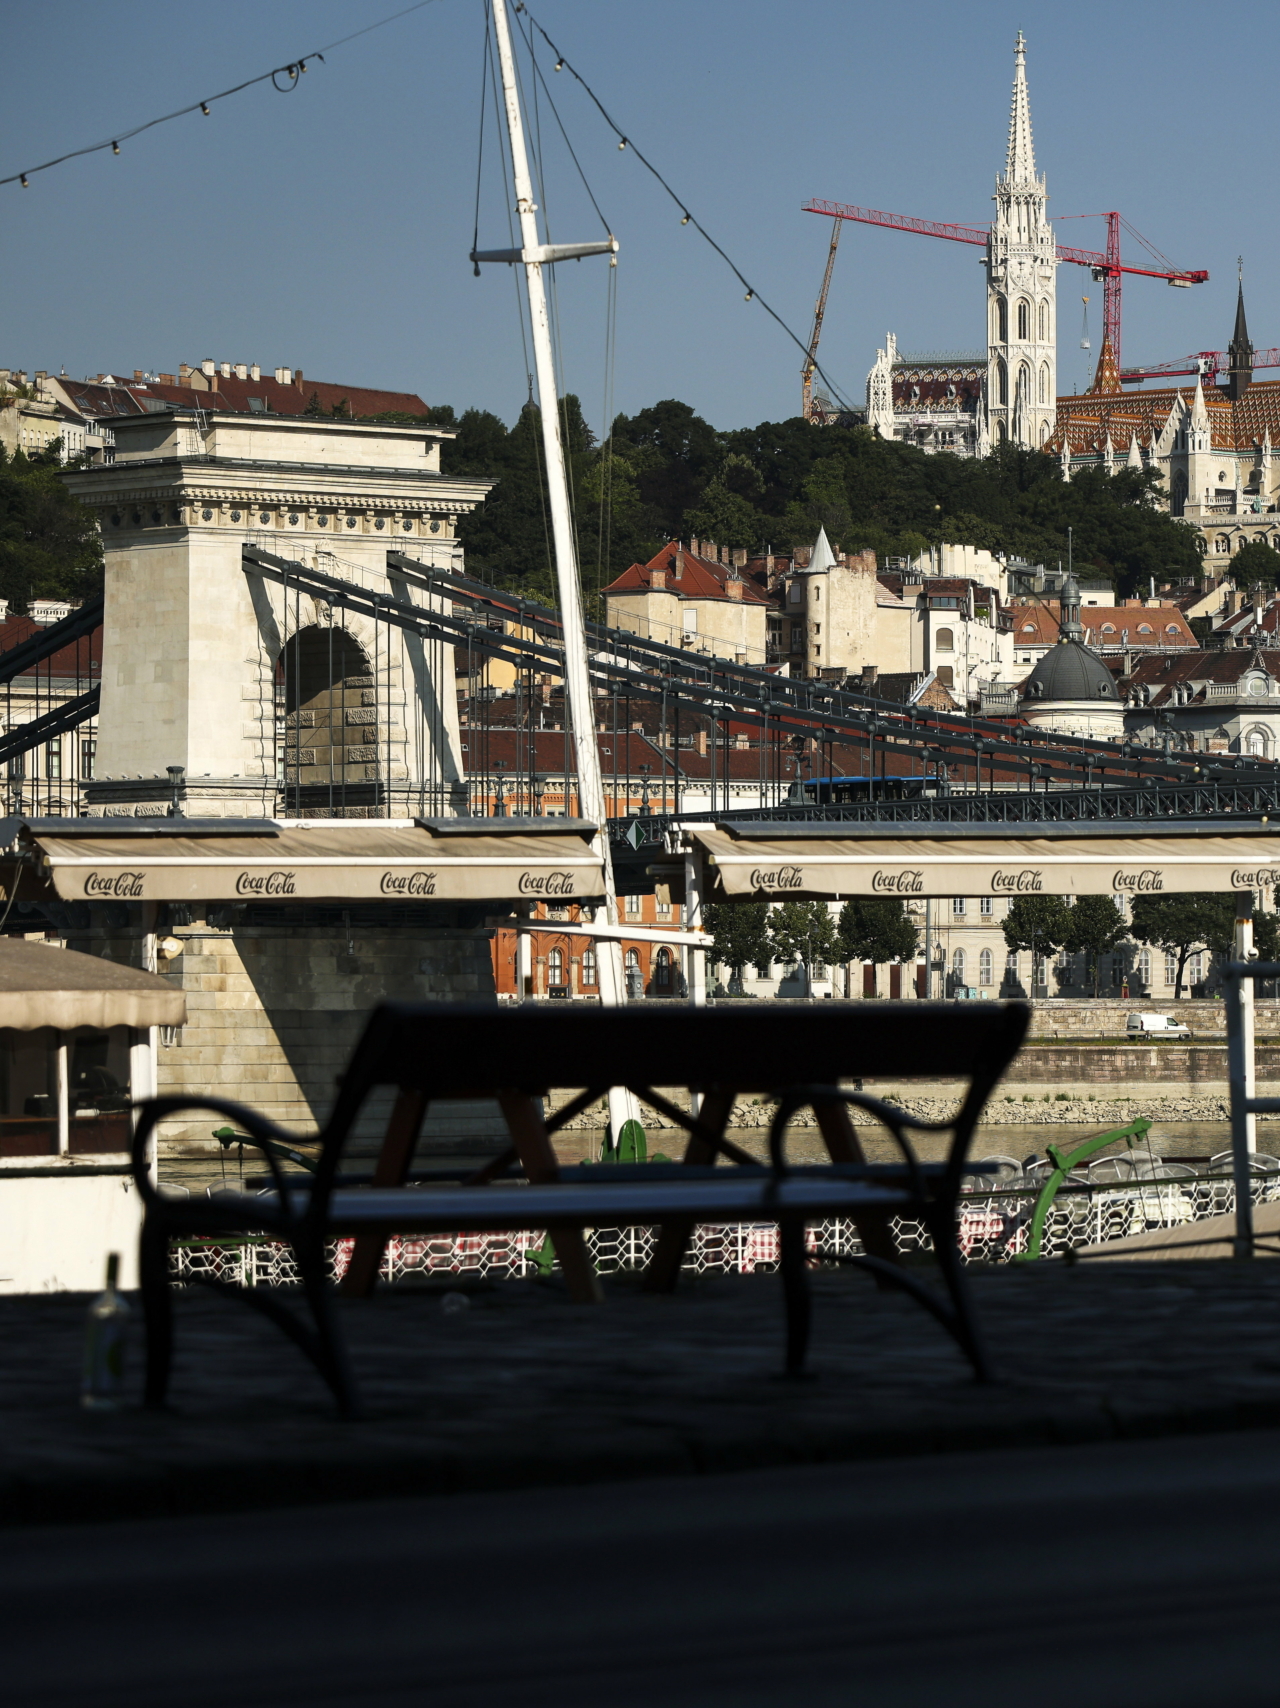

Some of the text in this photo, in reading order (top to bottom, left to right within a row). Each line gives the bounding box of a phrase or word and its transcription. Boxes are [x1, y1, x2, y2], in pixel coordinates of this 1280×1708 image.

[84, 872, 146, 896] Coca-Cola
[236, 872, 297, 895] Coca-Cola
[380, 872, 437, 895] Coca-Cola
[518, 872, 575, 895] Coca-Cola
[750, 866, 803, 889] Coca-Cola
[872, 871, 926, 893] Coca-Cola
[991, 870, 1043, 892] Coca-Cola
[1113, 870, 1164, 892] Coca-Cola
